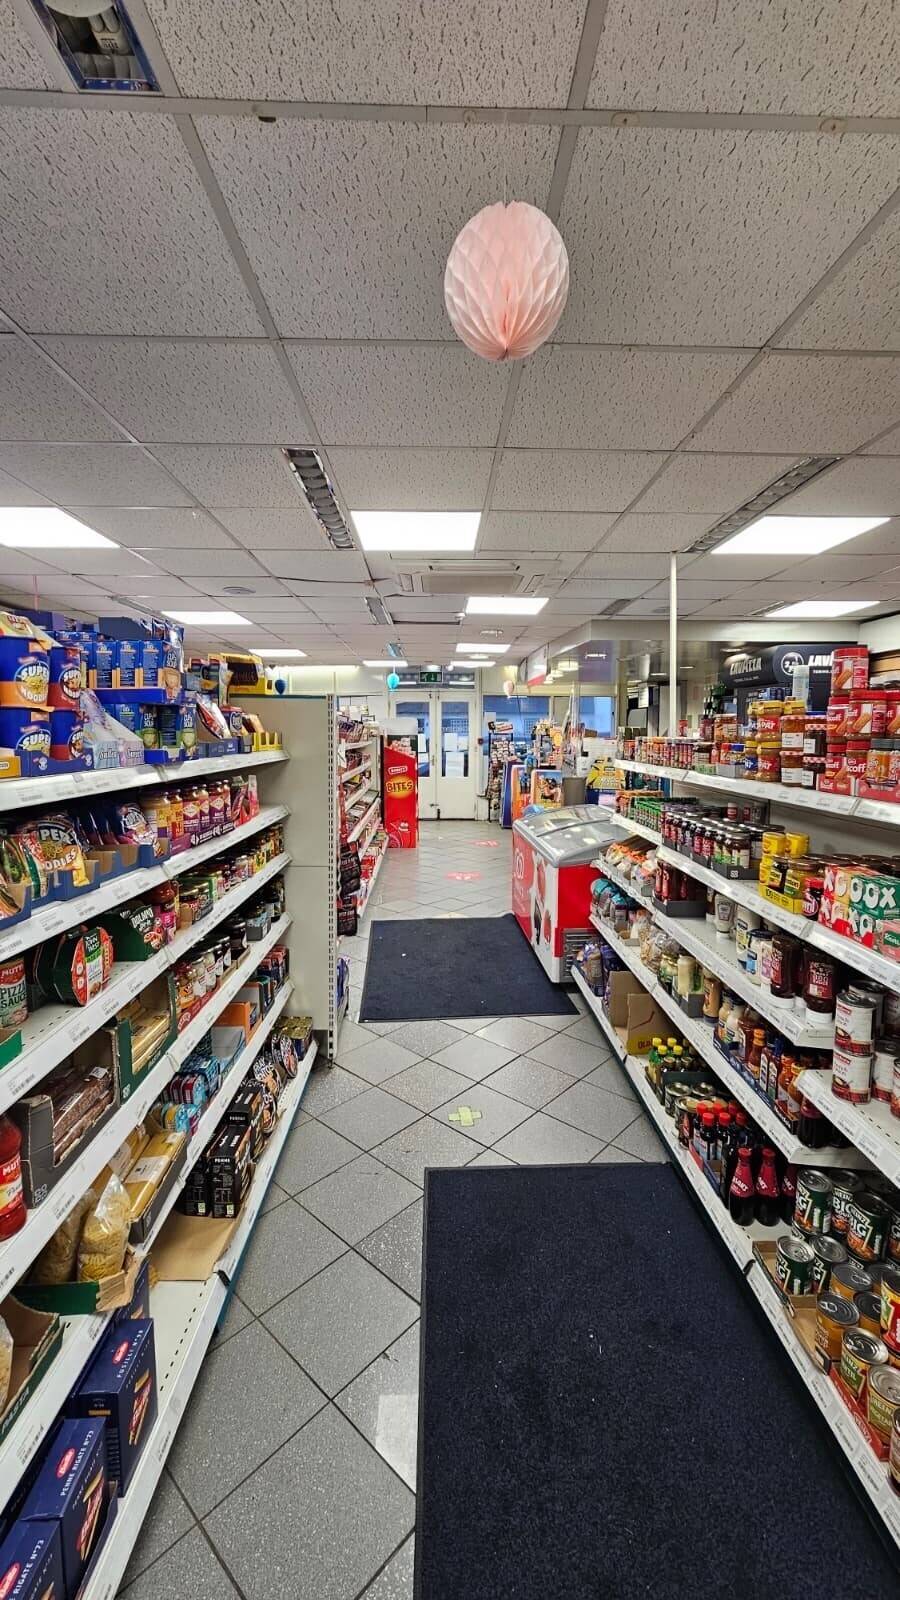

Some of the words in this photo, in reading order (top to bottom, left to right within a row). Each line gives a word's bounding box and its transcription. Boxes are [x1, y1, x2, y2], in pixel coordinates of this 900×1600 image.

[386, 779, 414, 792] BITES
[60, 1473, 75, 1497] PENNE
[13, 1562, 33, 1594] RIGATE
